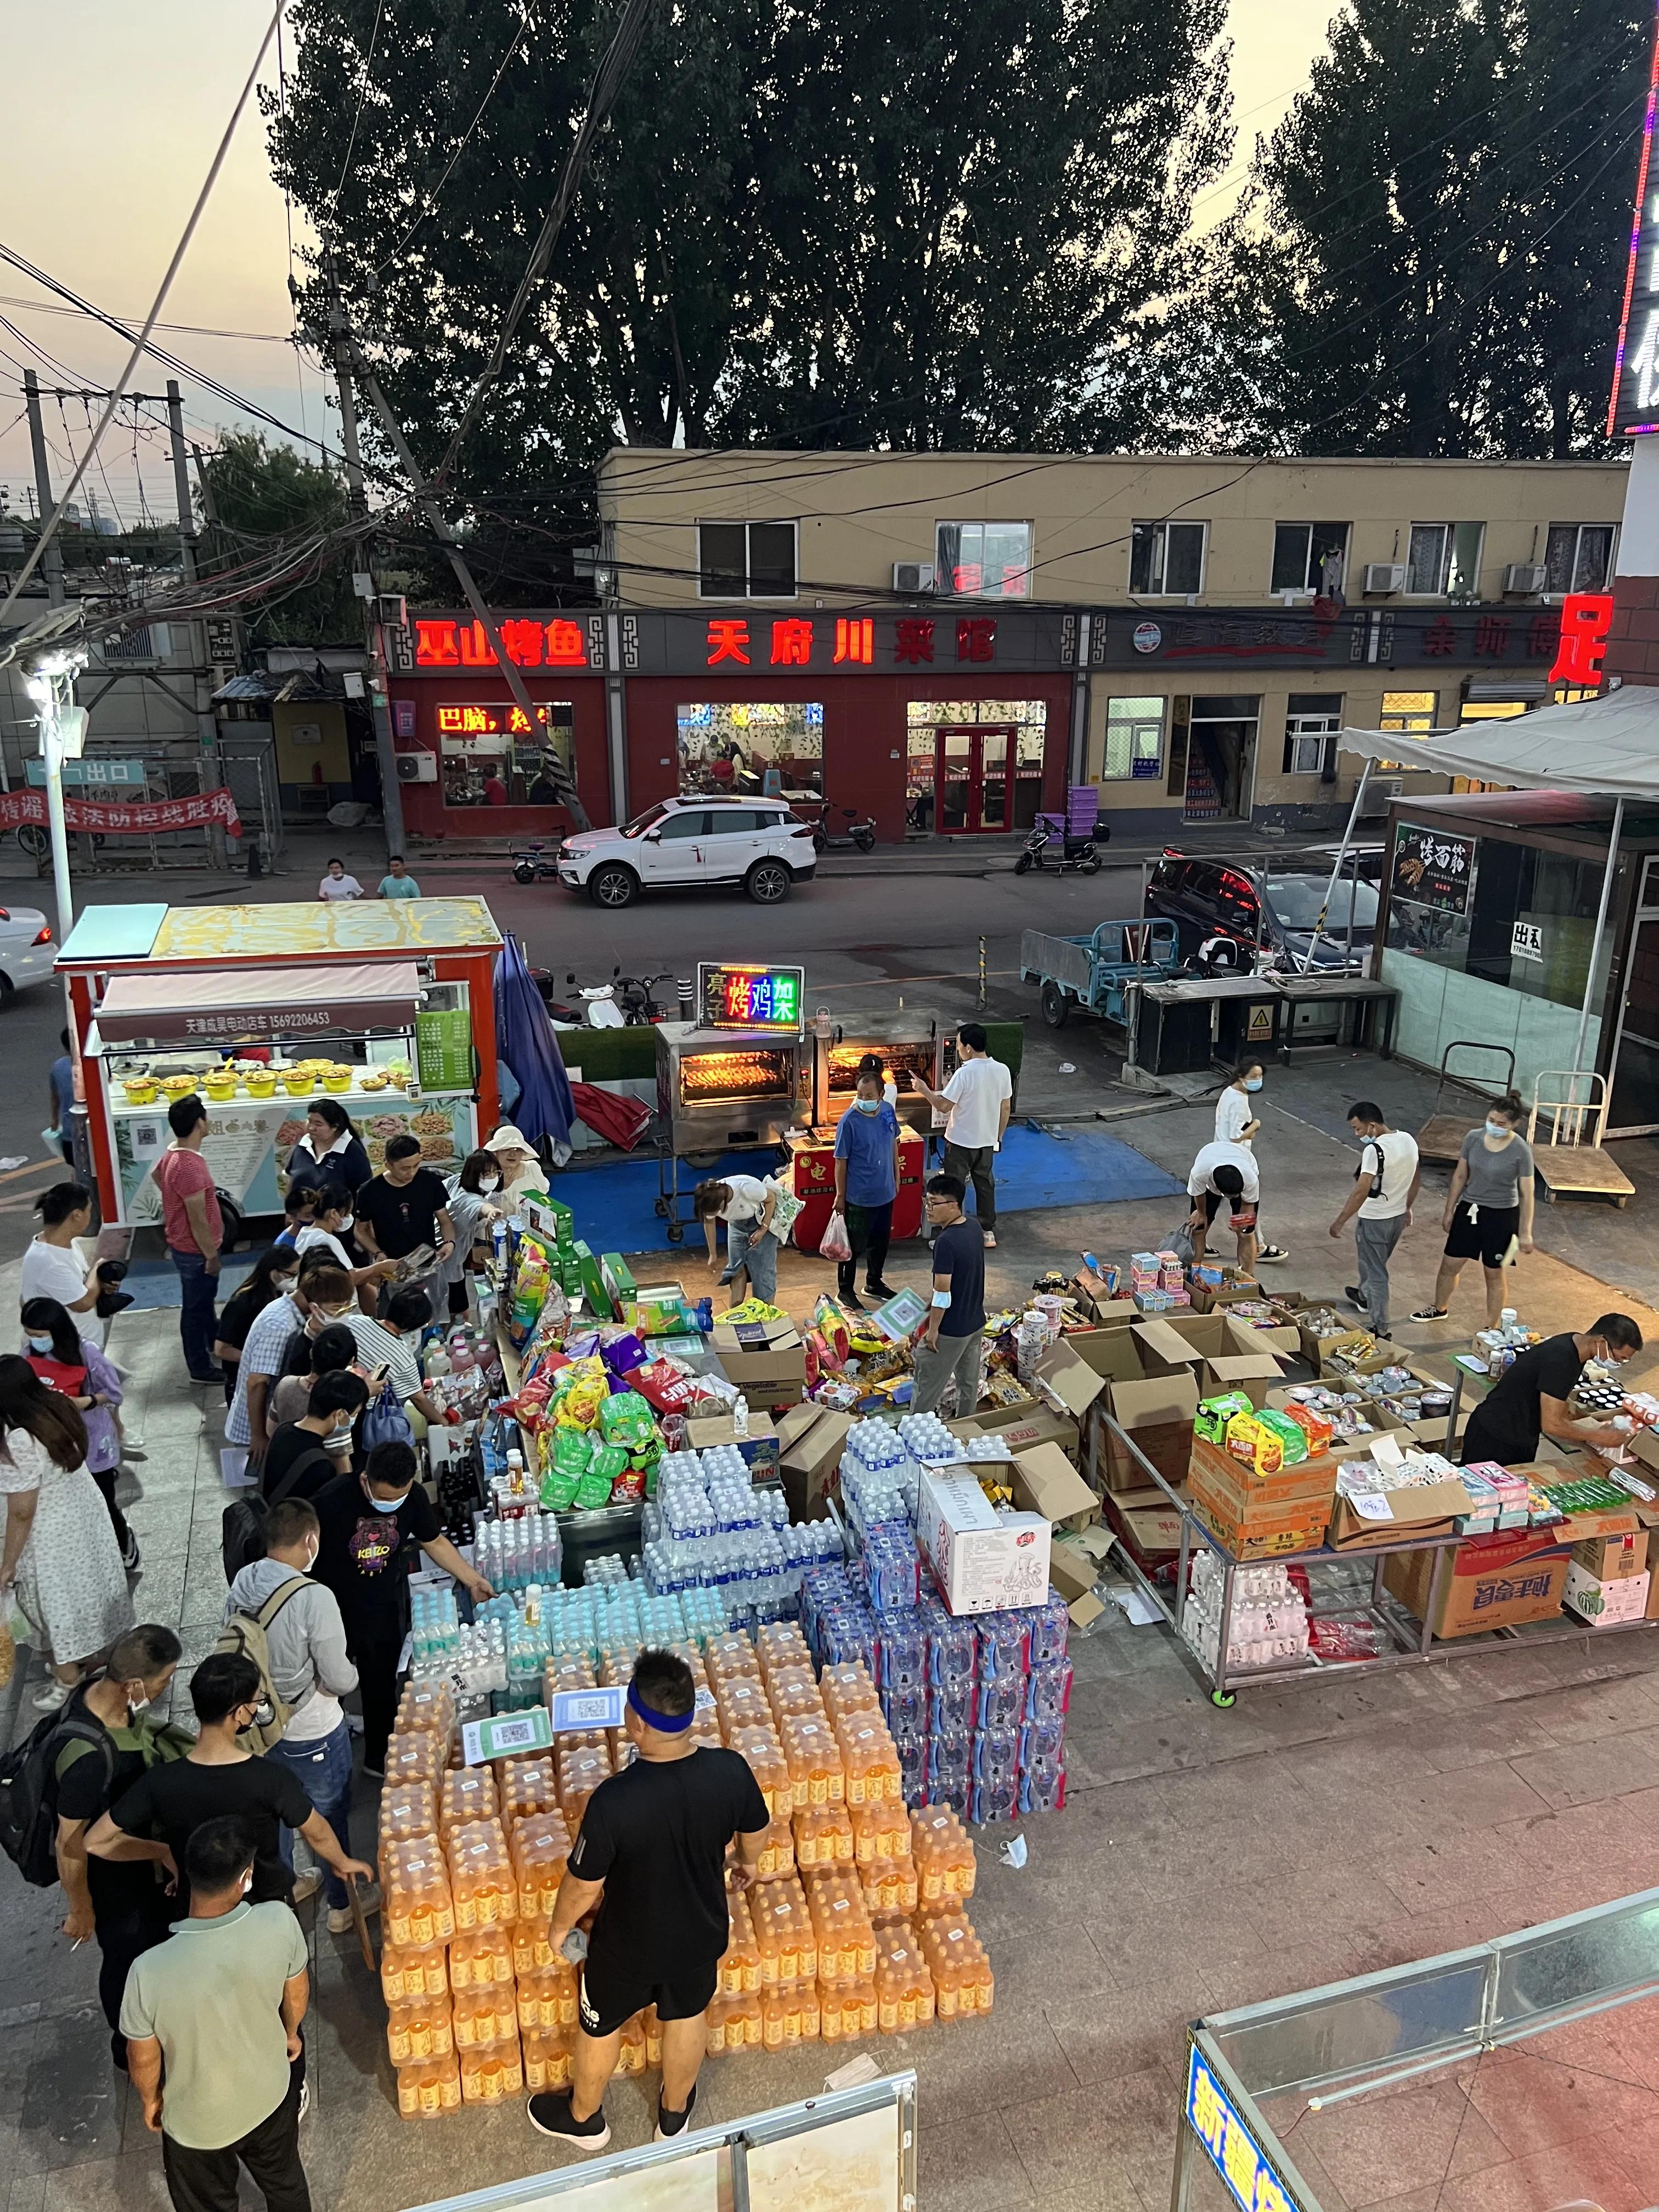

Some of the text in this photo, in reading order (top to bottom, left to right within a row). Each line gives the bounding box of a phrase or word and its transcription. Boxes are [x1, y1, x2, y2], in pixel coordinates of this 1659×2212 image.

[415, 618, 587, 667] 巫山烤鱼
[707, 618, 997, 665] 天府川菜馆
[1548, 594, 1613, 685] 足
[87, 763, 129, 782] 出口
[1420, 835, 1466, 874] 烤面筋
[1514, 924, 1541, 950] 出租
[707, 973, 727, 1020] 亮子
[729, 976, 794, 1020] 烤鸡架
[269, 1012, 330, 1028] 15692206453
[743, 1381, 777, 1391] Vegetable
[358, 1545, 390, 1559] KENZO
